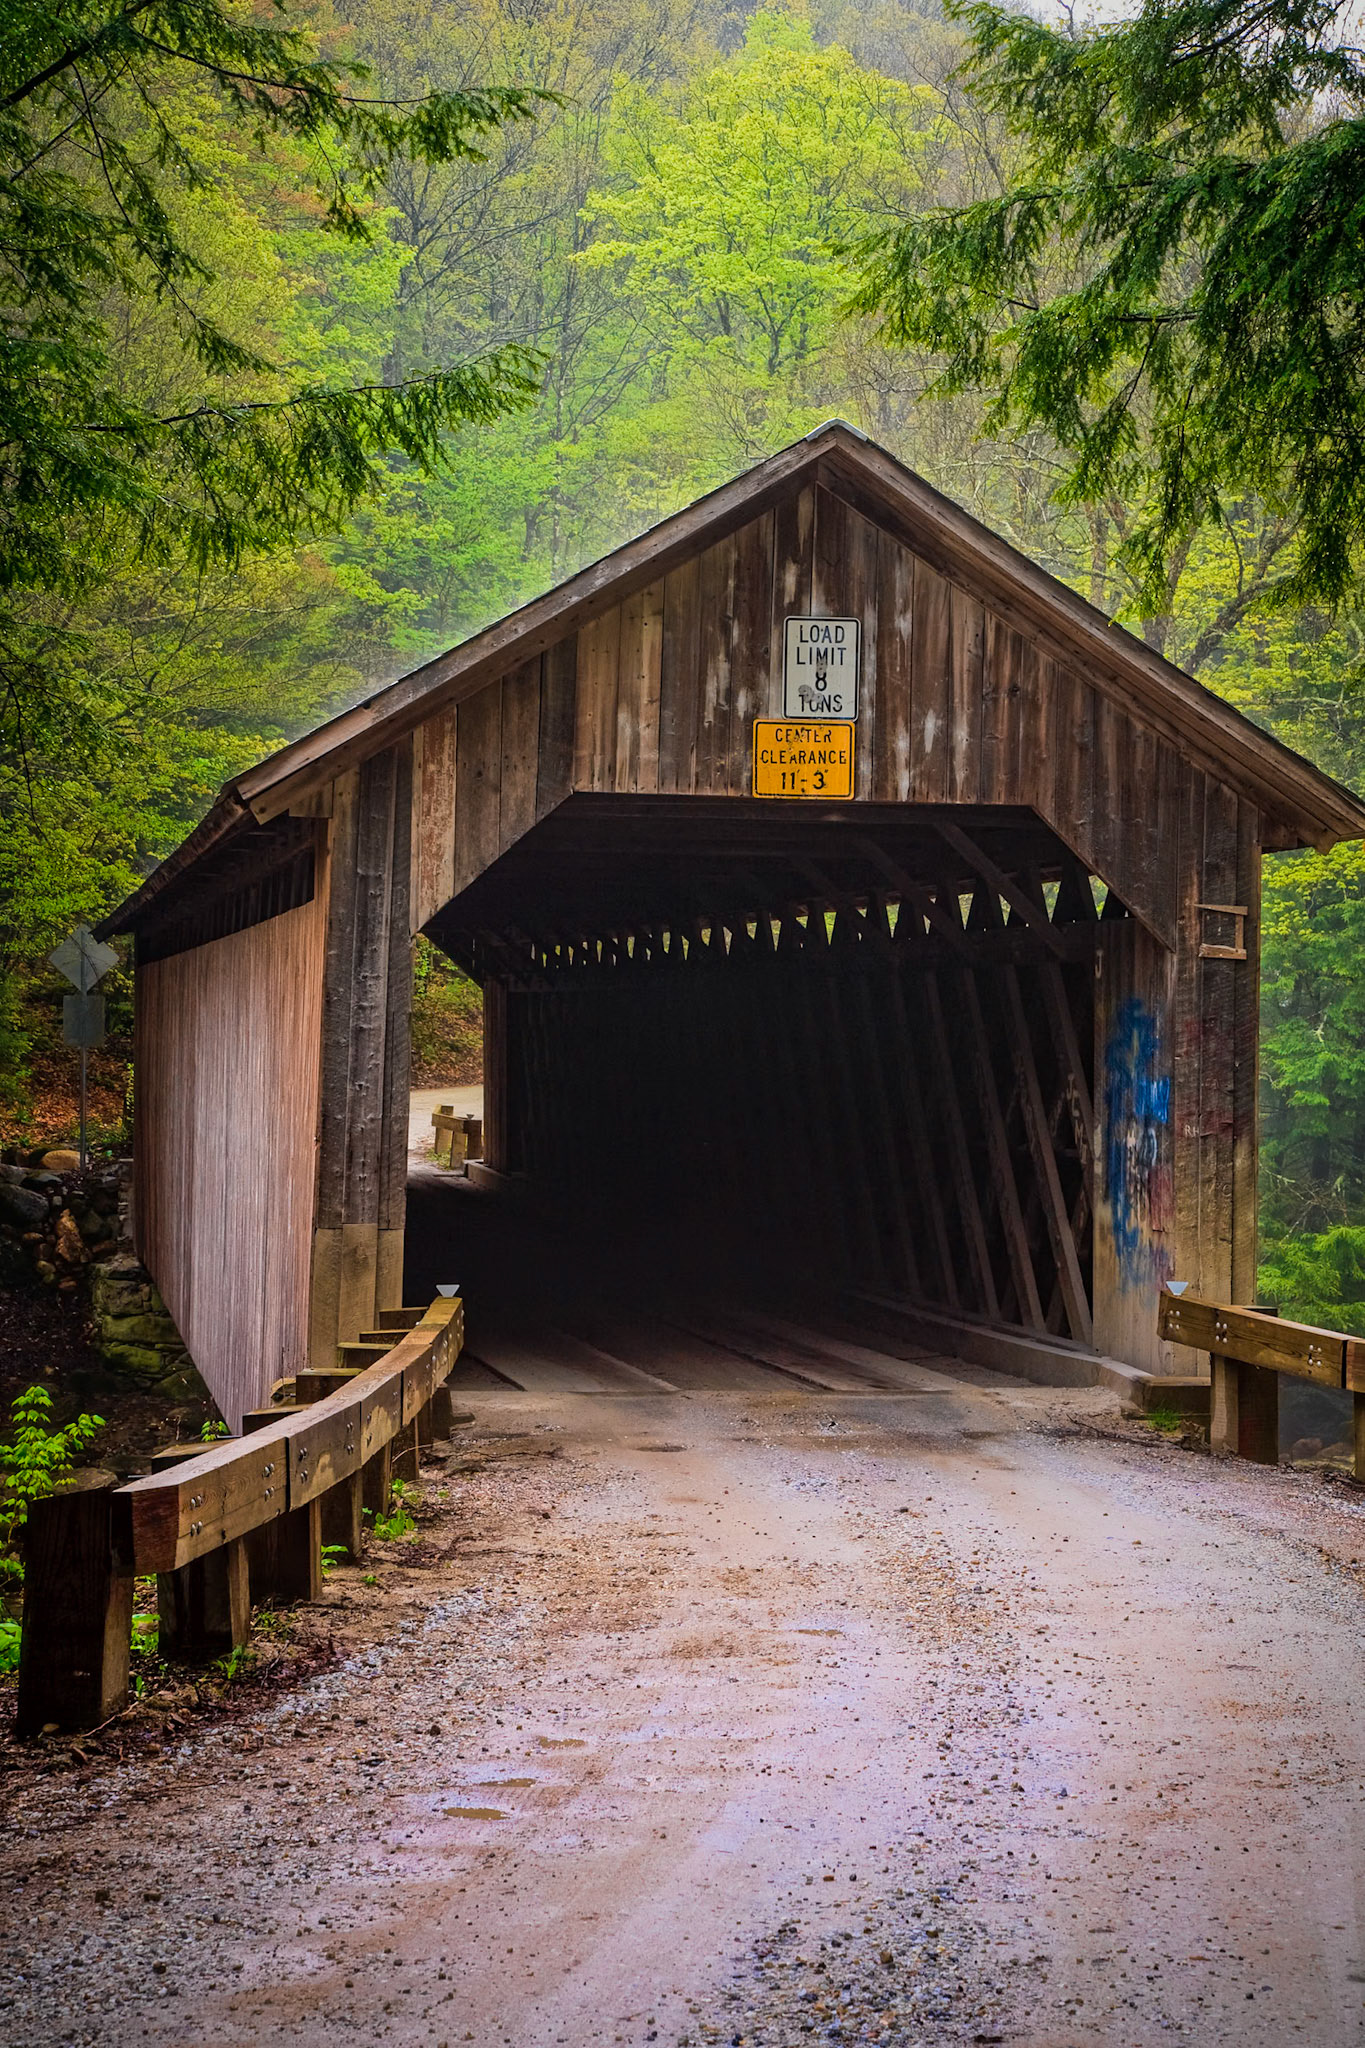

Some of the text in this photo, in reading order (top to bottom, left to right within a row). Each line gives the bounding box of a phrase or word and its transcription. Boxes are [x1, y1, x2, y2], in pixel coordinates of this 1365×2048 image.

[799, 625, 845, 643] LOAD
[796, 647, 847, 666] LIMIT
[815, 671, 827, 691] 8
[799, 694, 843, 713] TONS
[775, 728, 832, 743] CENTER
[760, 750, 847, 765] CLEARANCE
